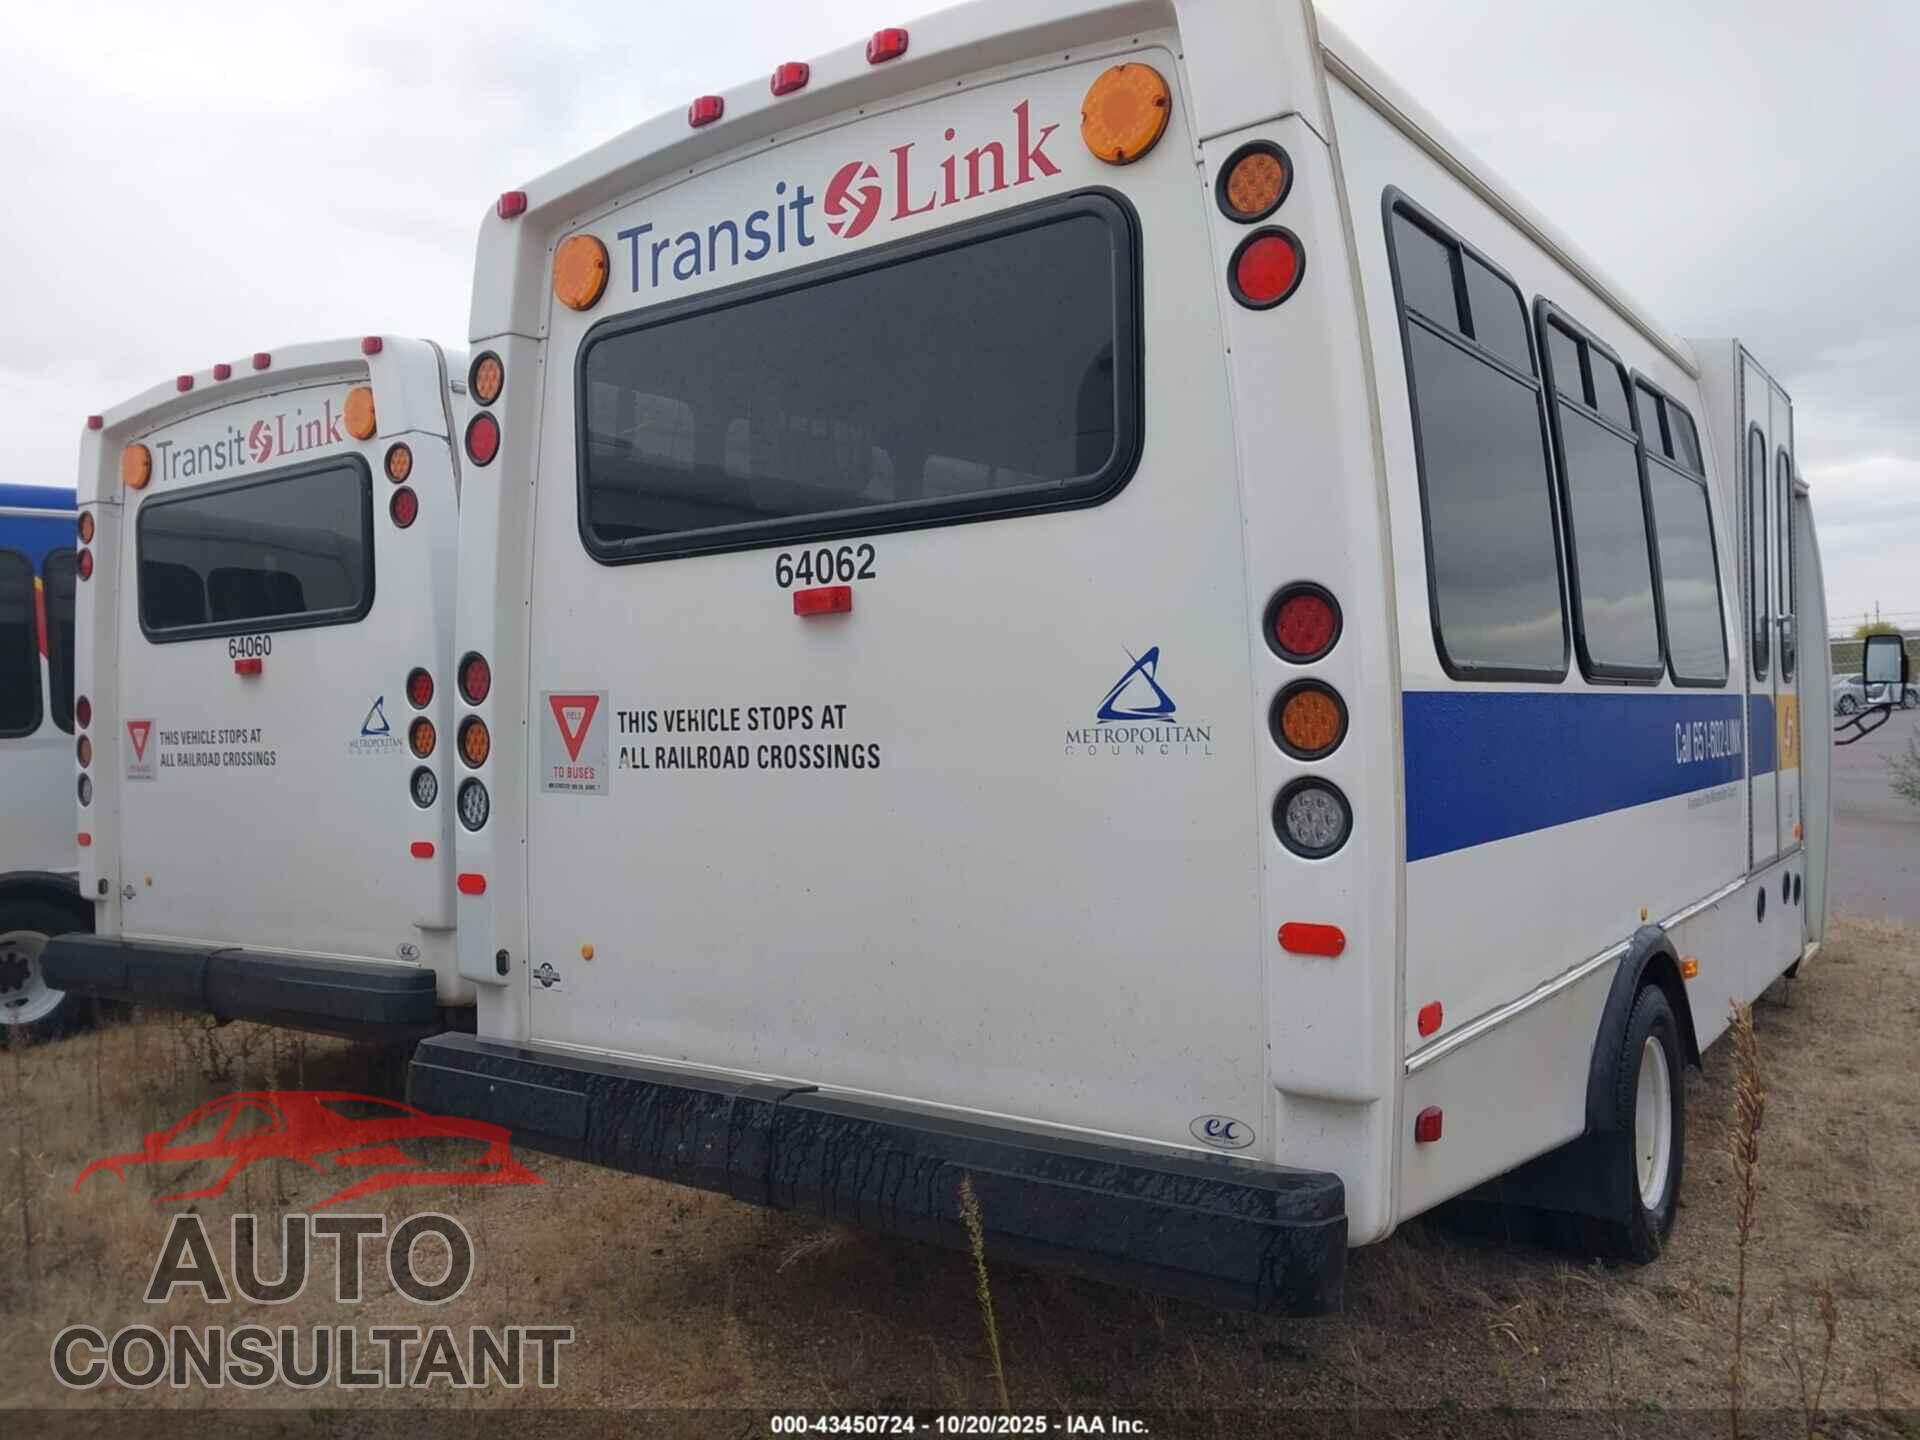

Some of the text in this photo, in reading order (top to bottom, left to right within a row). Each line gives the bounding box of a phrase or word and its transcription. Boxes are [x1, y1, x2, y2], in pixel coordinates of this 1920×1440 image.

[617, 99, 1062, 293] Transit Link
[156, 398, 344, 481] Transit Link
[775, 543, 876, 588] 64062
[229, 634, 272, 659] 64060
[617, 704, 847, 733] THIS VEHICLE STOPS AT
[160, 728, 262, 745] THIS VEHICLE STOPS AT
[1065, 726, 1212, 744] METROPOLITAN
[1675, 721, 1692, 764] Call
[160, 750, 277, 767] ALL RAILROAD CROSSINGS
[619, 743, 880, 769] ALL RAILROAD CROSSINGS
[1064, 743, 1213, 756] COUNCIL
[553, 766, 595, 780] TO BUSES
